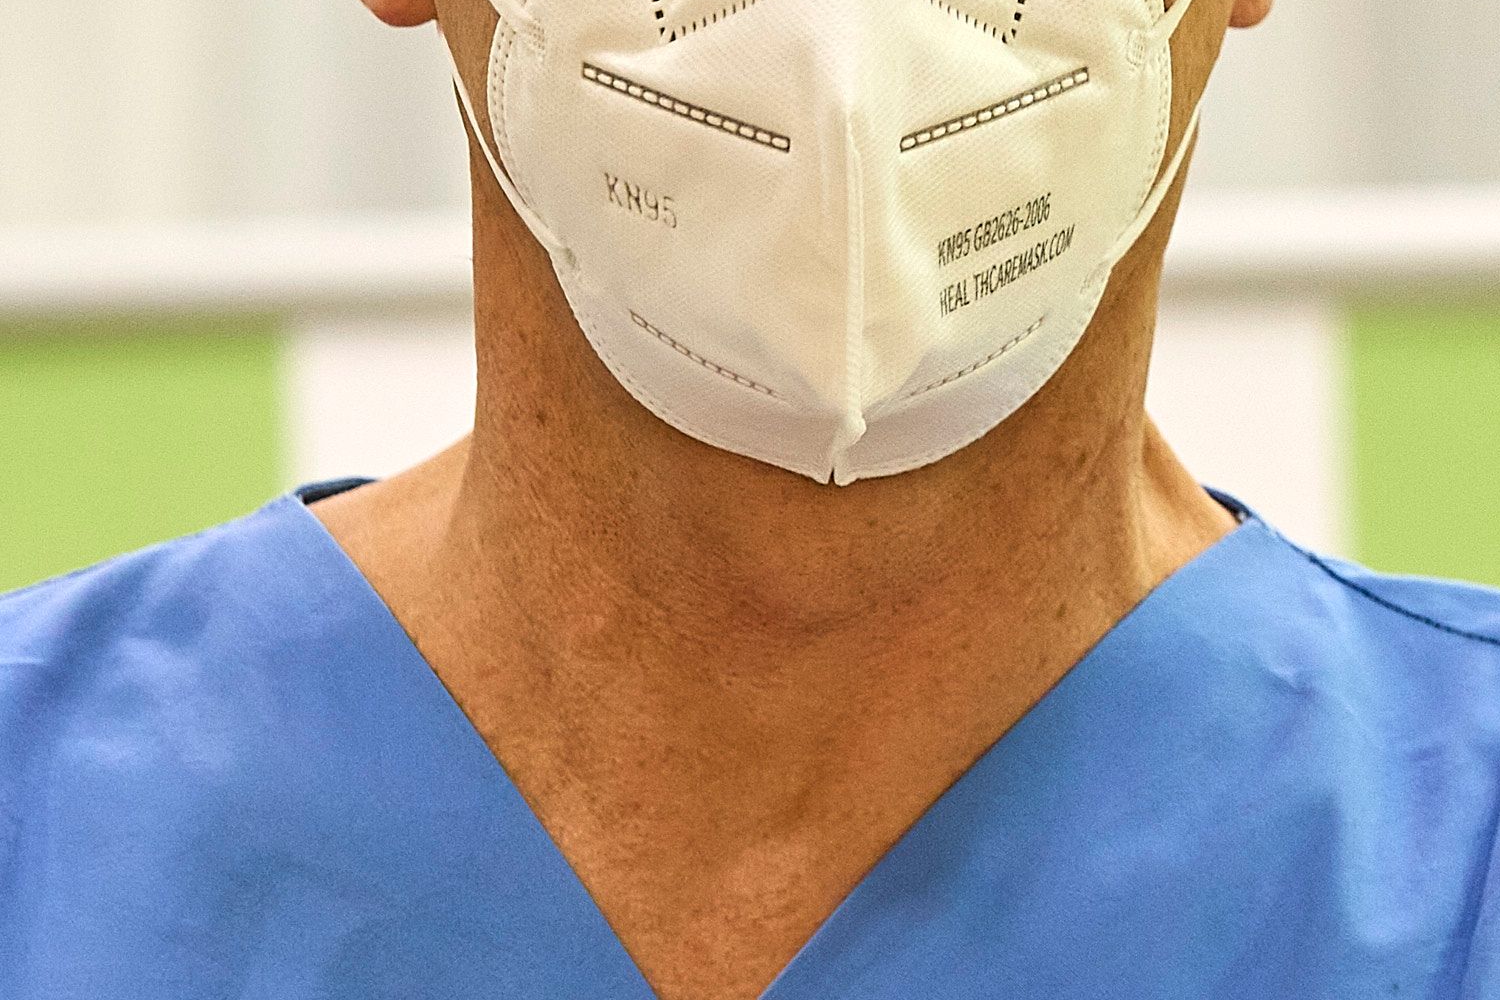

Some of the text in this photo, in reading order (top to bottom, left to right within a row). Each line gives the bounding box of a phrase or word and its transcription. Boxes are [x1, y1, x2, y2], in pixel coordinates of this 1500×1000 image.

[603, 172, 678, 229] KN95
[937, 191, 1051, 270] KN95 GB2626-2006
[939, 279, 970, 318] HEAL
